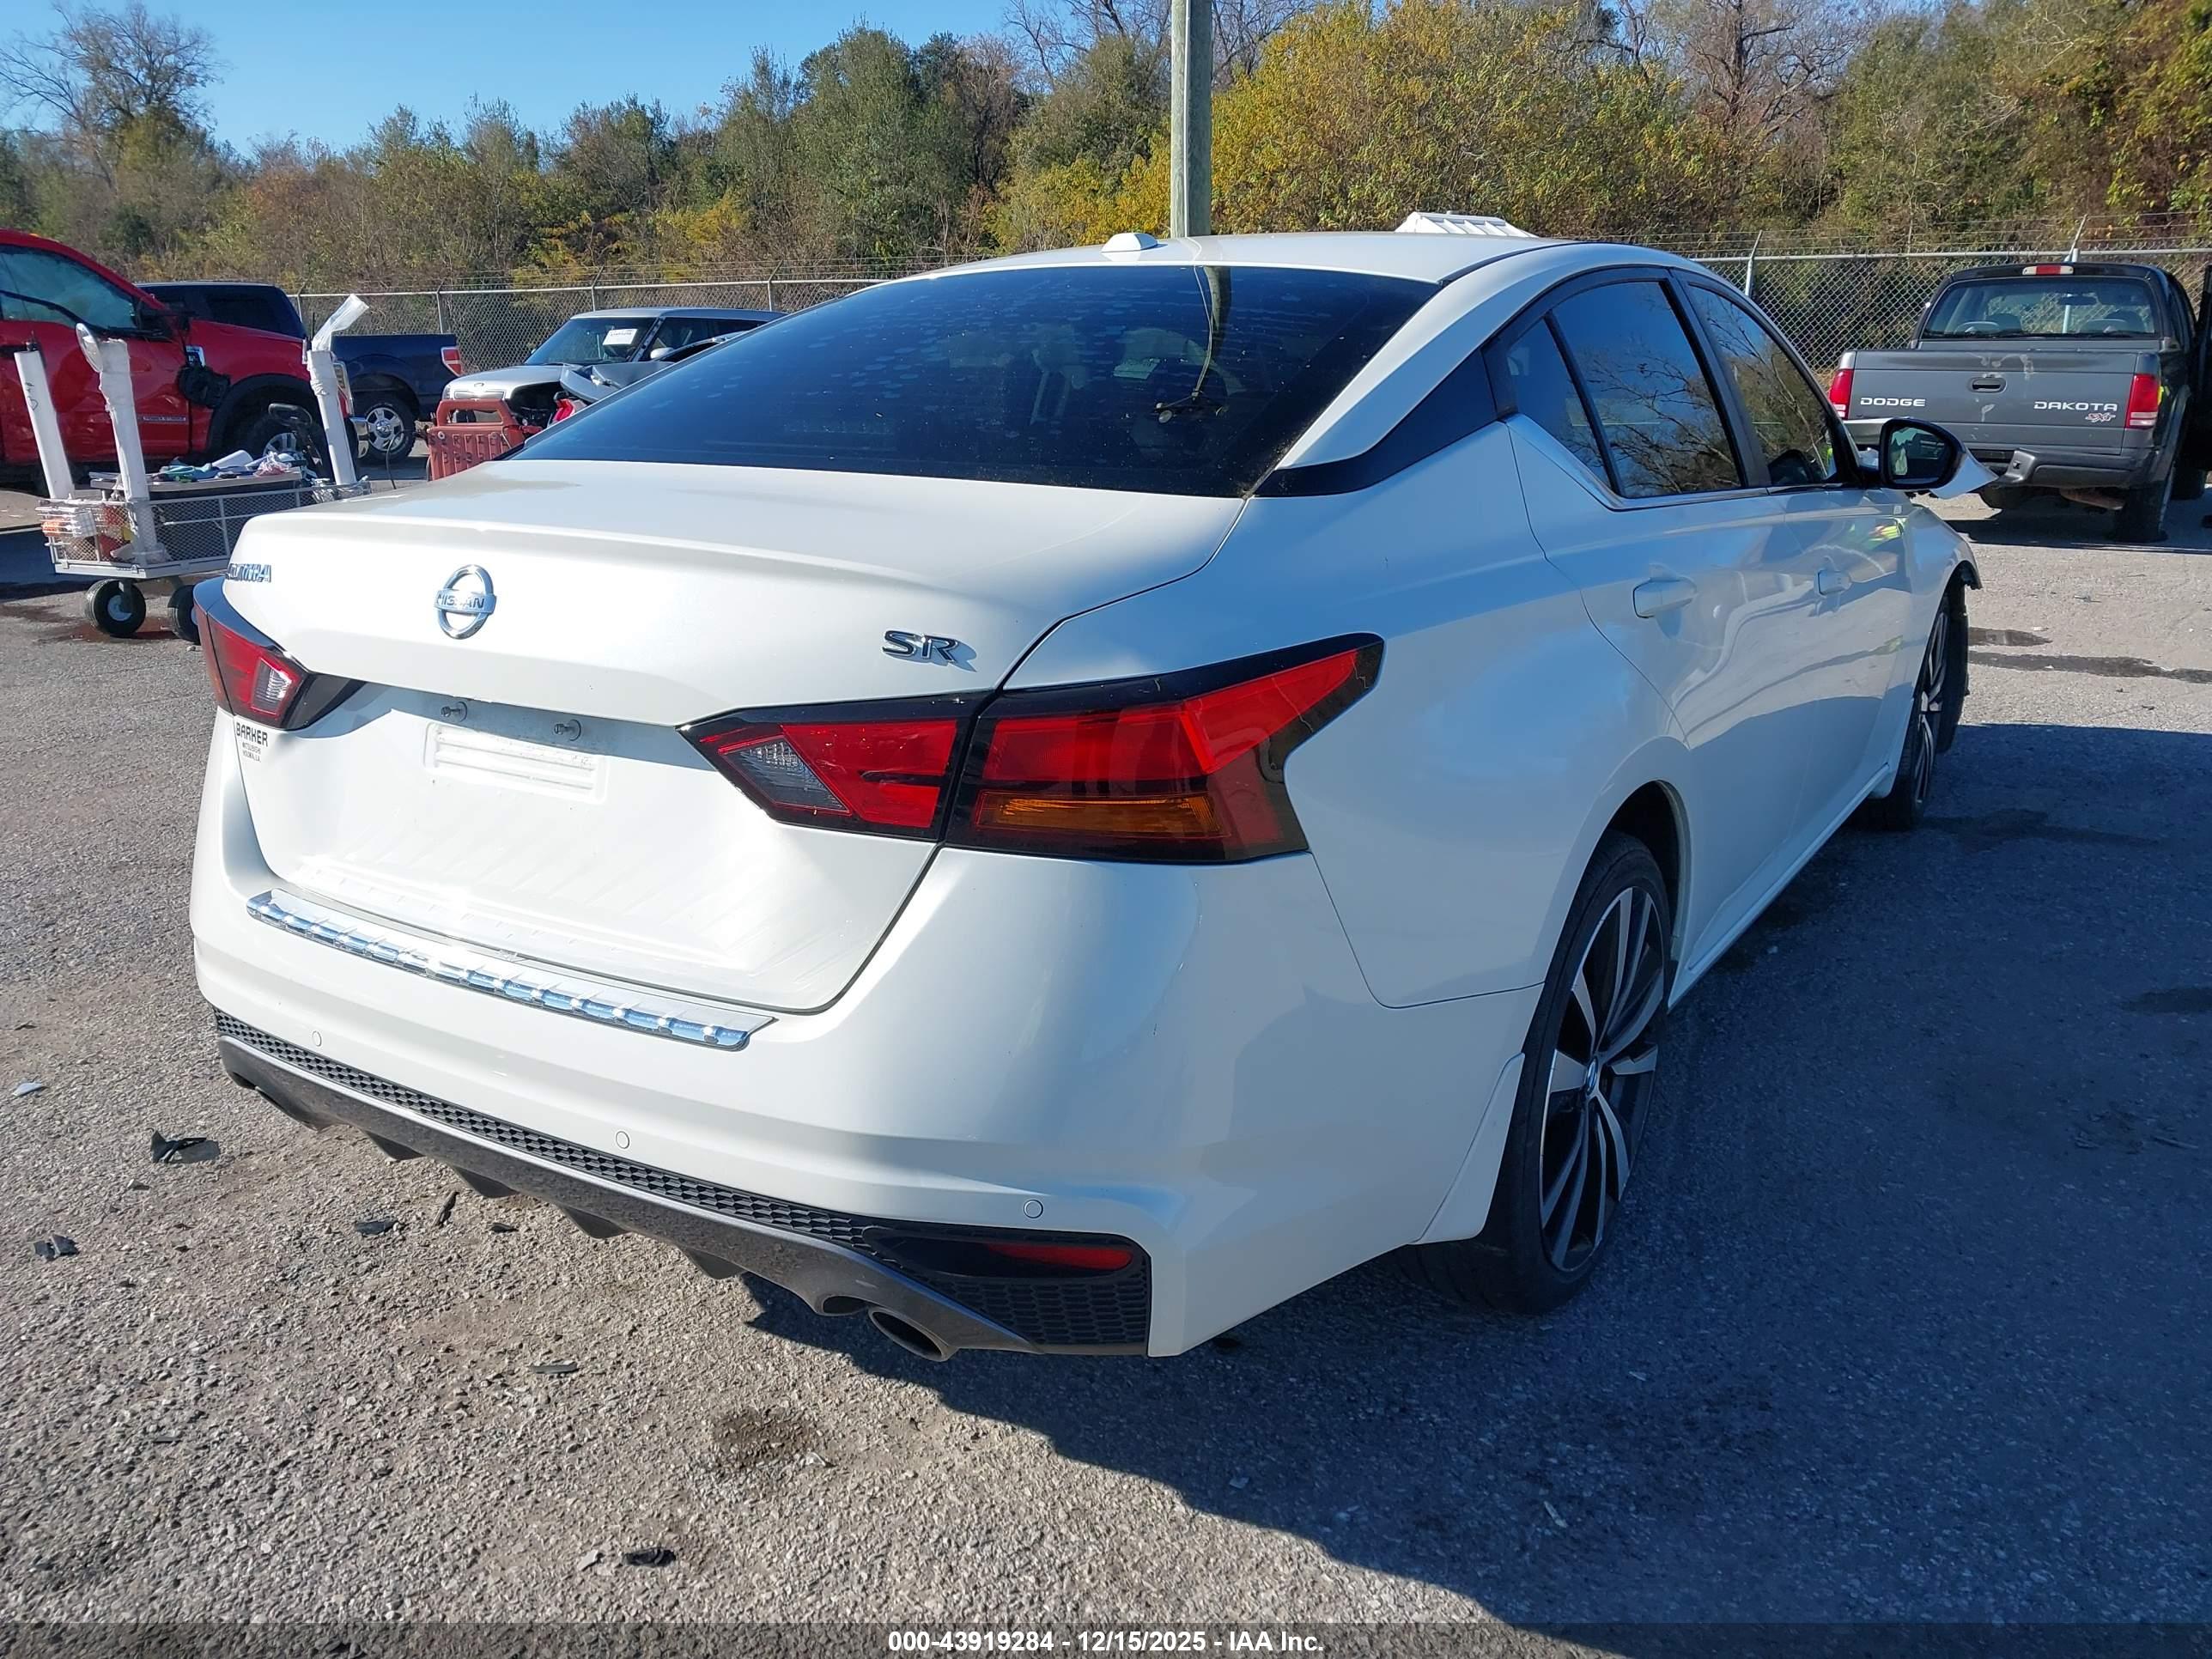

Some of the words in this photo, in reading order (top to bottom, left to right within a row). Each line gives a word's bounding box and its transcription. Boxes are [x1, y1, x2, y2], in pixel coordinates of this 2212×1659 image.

[1860, 397, 1926, 407] DODGE
[2033, 401, 2118, 411] DAKOTA
[436, 593, 485, 609] NISAN
[882, 630, 957, 663] SR
[236, 722, 268, 747] BARKER
